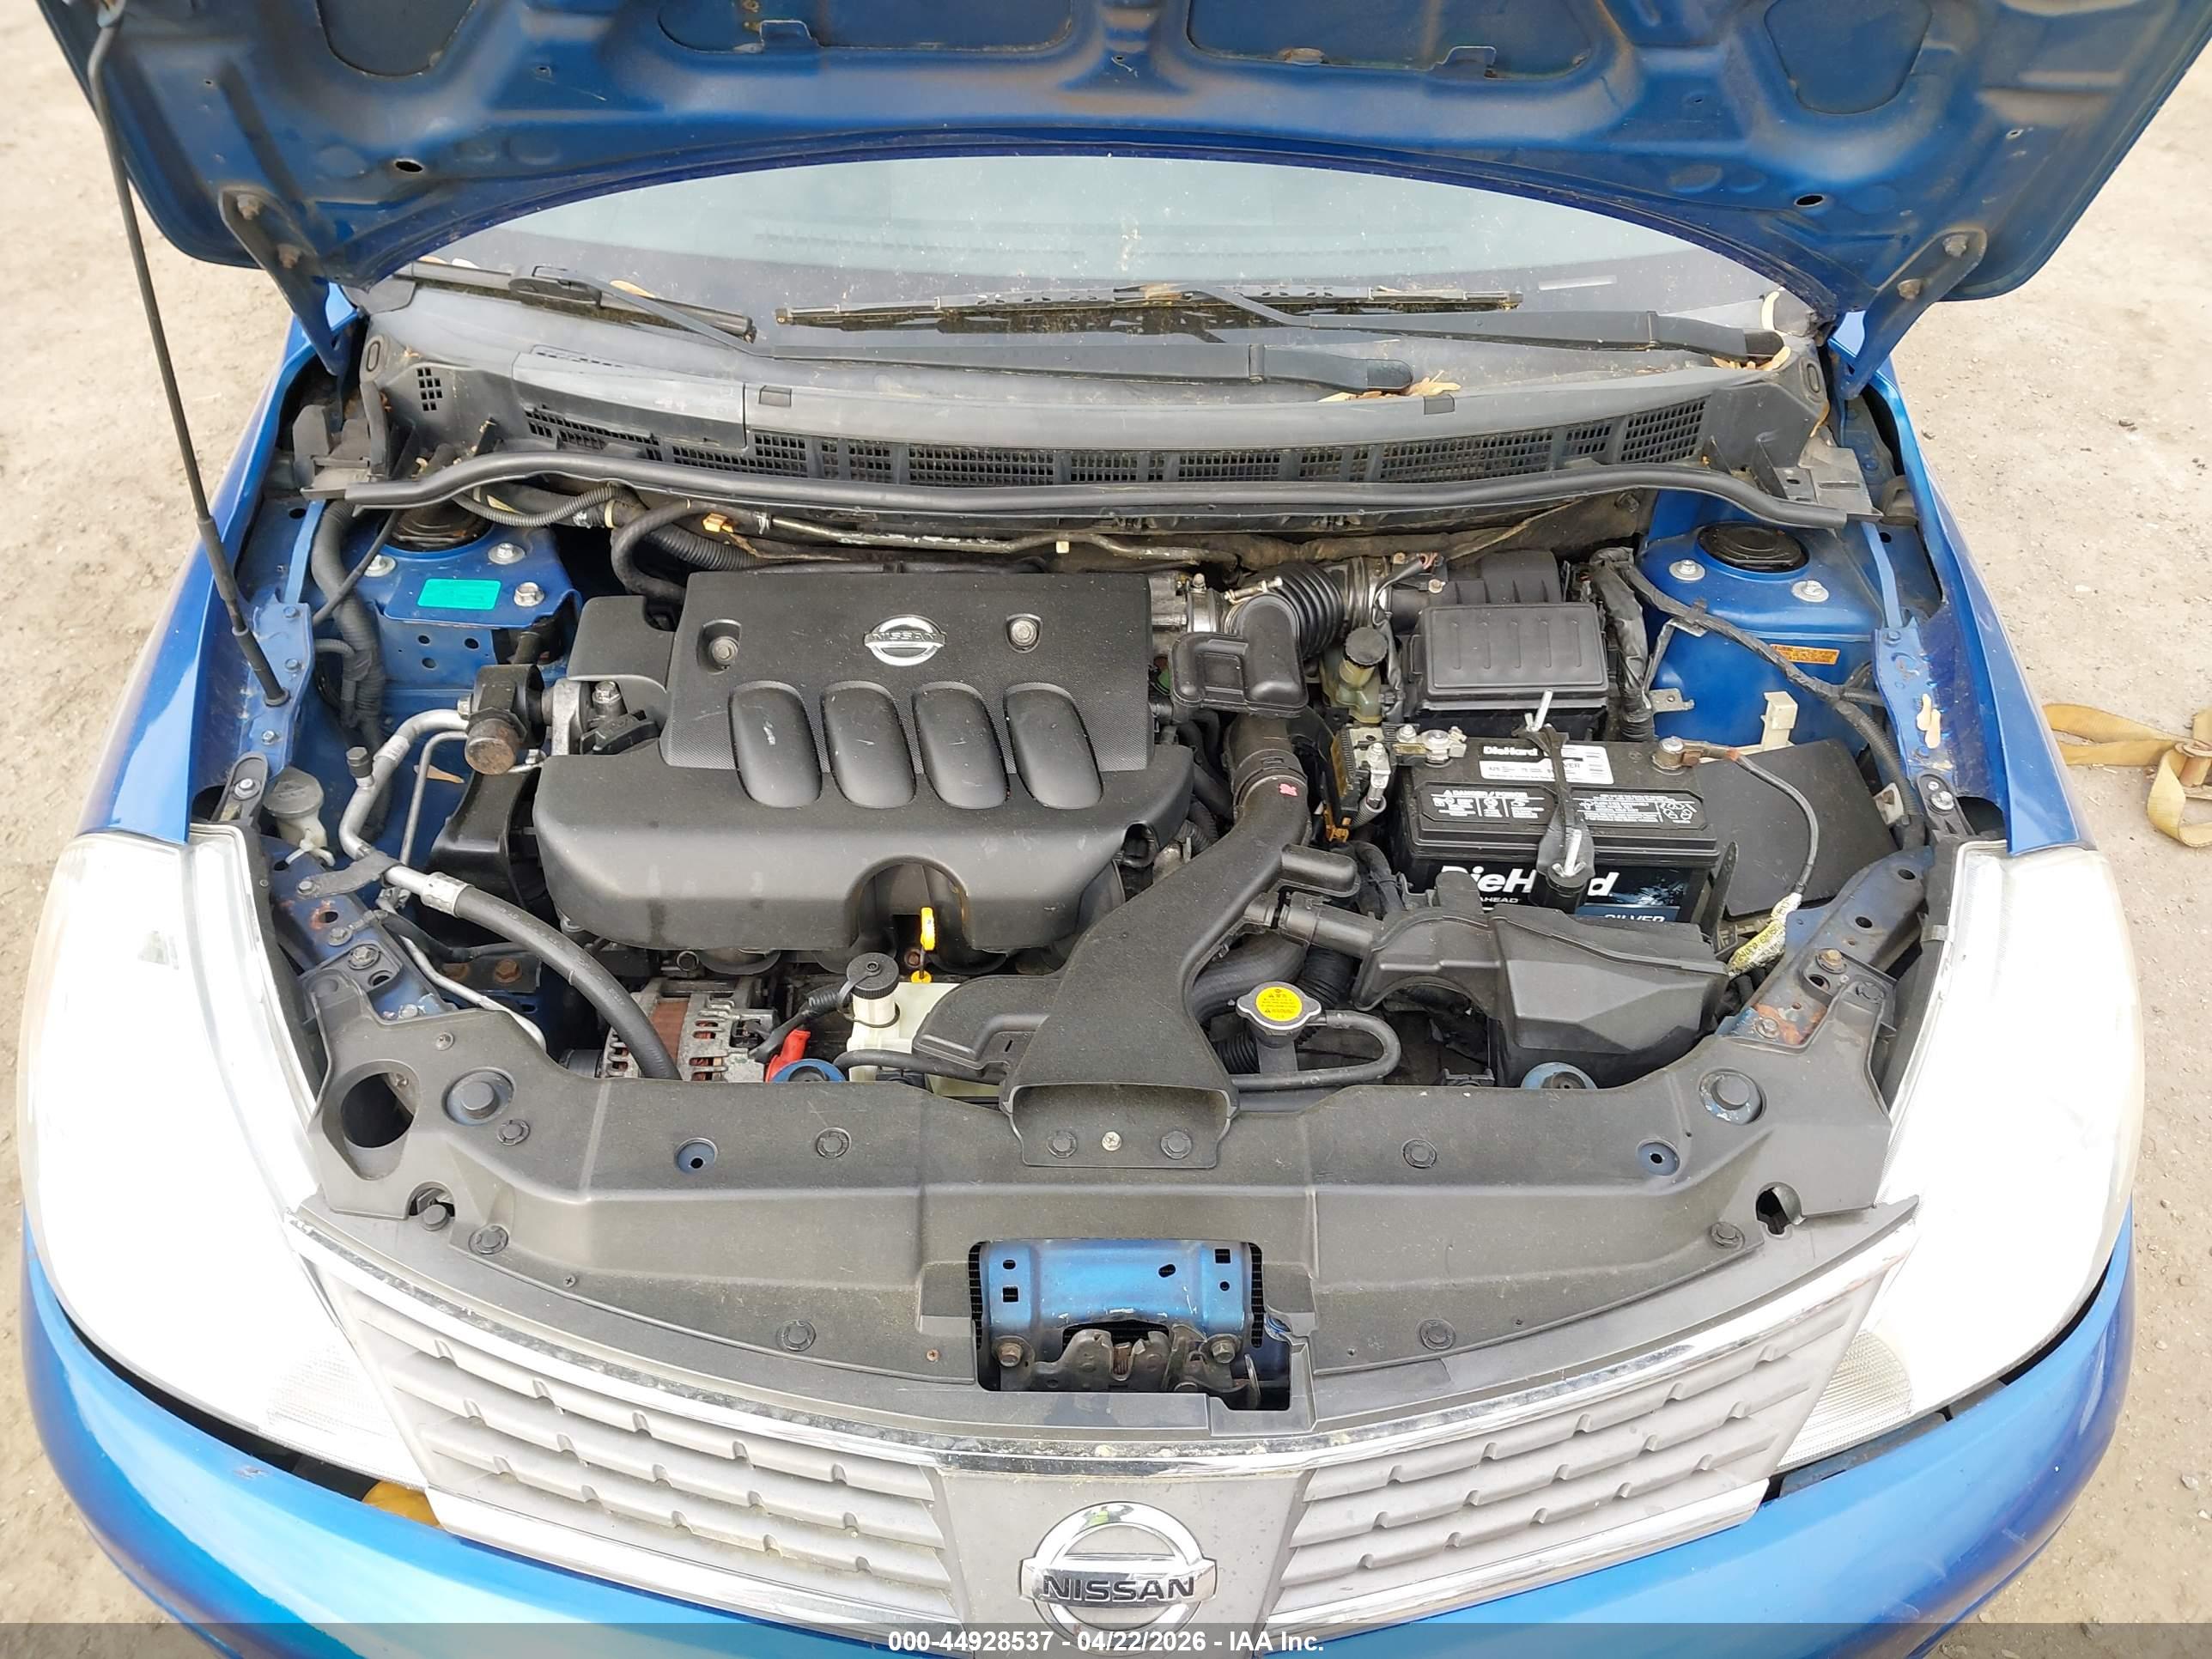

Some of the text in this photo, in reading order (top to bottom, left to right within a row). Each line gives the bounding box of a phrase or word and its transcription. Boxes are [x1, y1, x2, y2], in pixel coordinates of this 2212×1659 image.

[872, 632, 937, 641] NISSAN
[1483, 745, 1539, 757] DieHard
[1042, 1574, 1195, 1601] NISSAN
